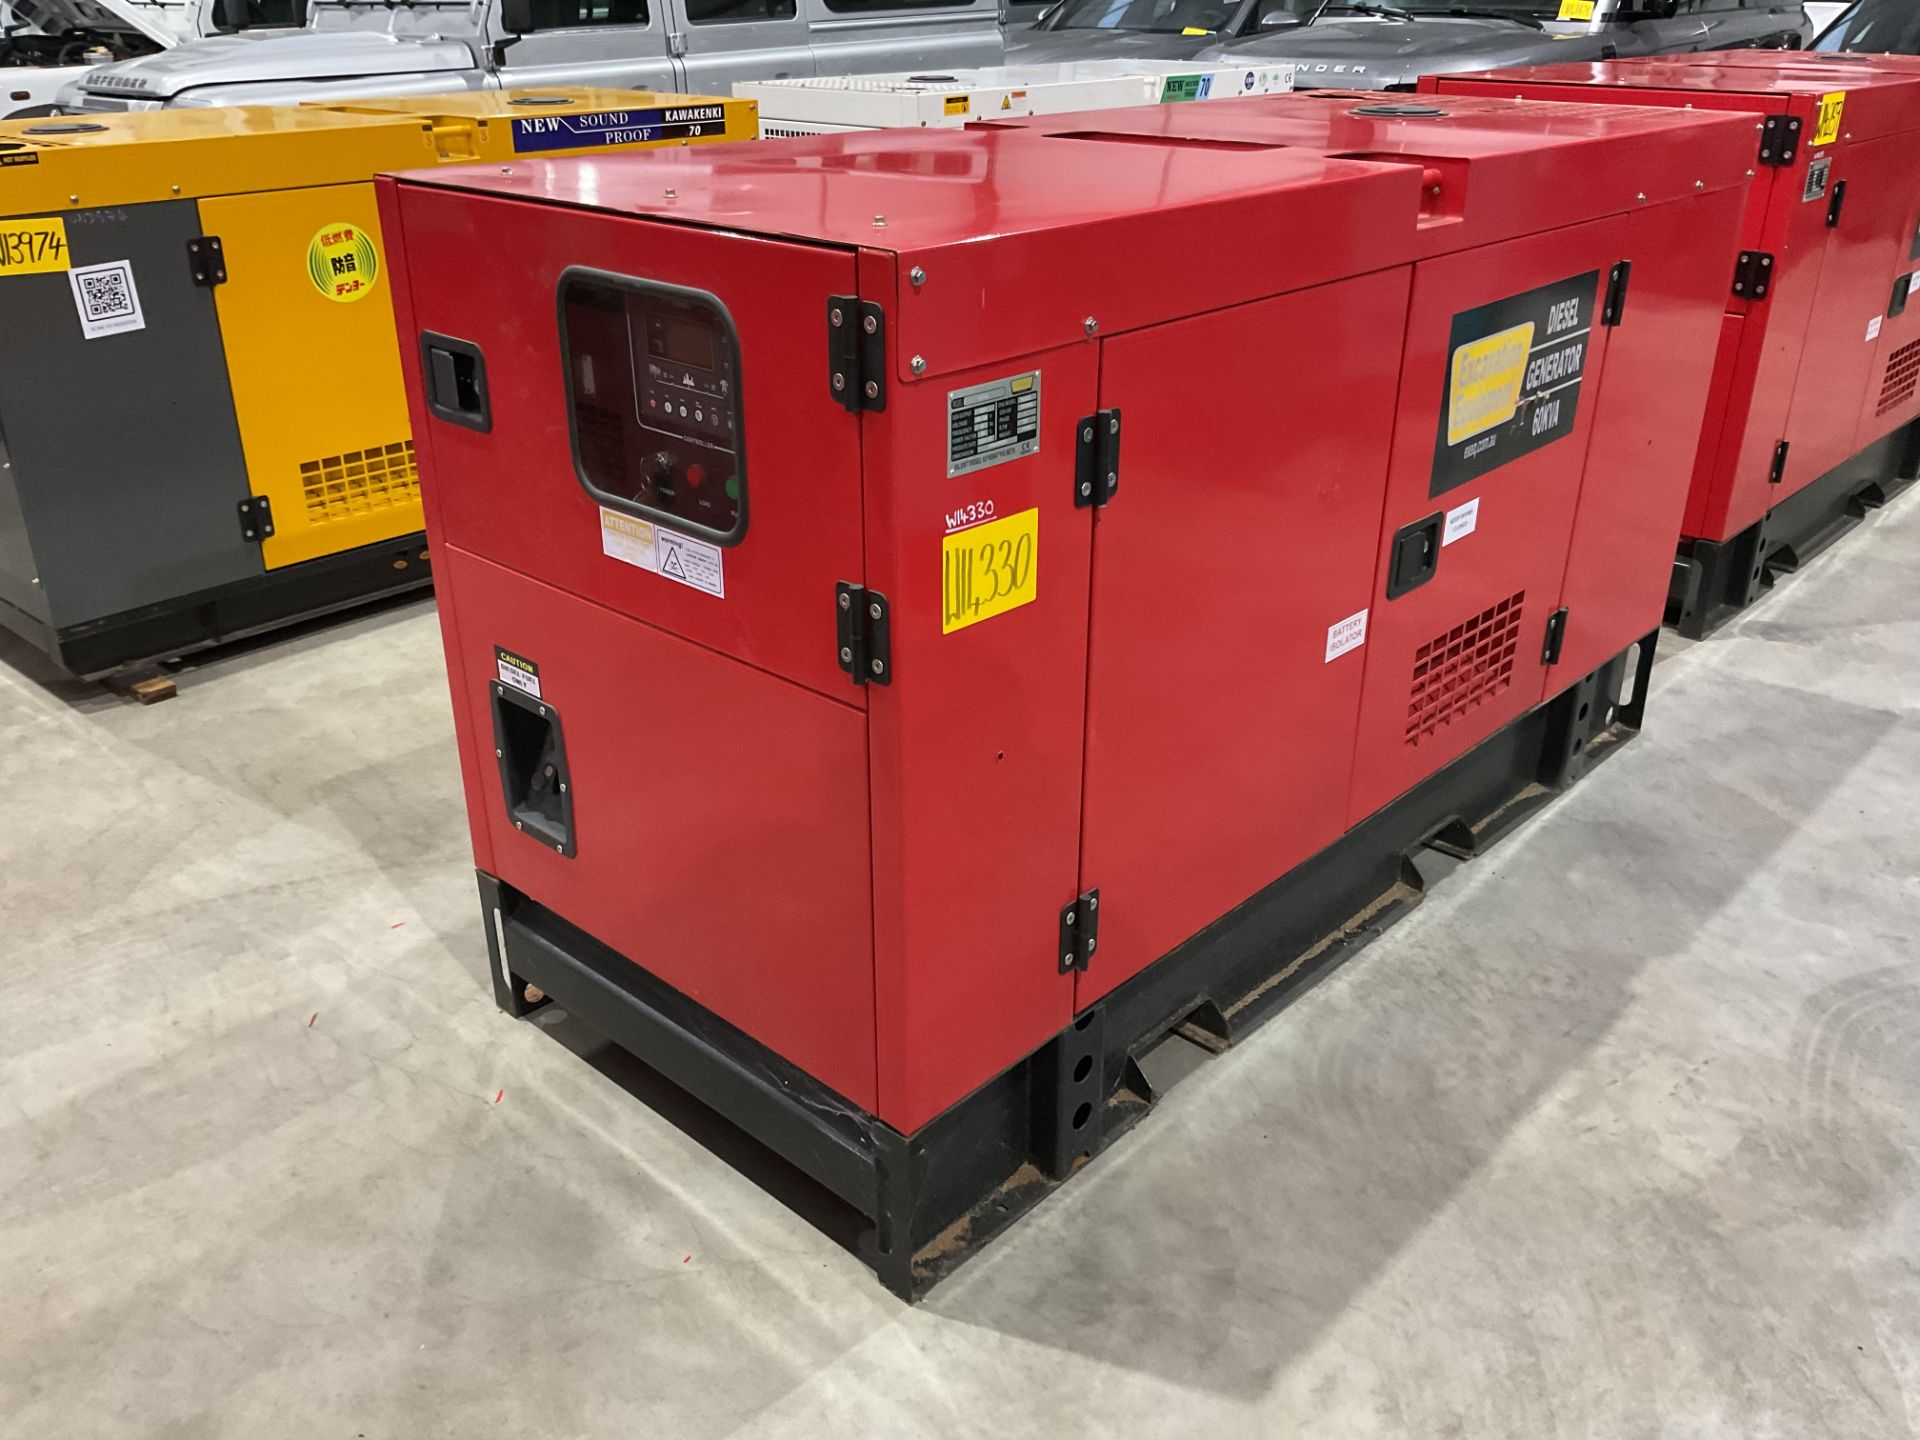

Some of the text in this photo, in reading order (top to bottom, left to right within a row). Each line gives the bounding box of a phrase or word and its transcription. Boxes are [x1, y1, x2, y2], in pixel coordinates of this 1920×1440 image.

[1166, 80, 1185, 92] NEW
[1200, 78, 1211, 96] 70
[521, 112, 629, 134] NEW SOUND
[665, 107, 722, 122] KAWAKENKI
[605, 129, 651, 144] PROOF
[689, 125, 701, 137] 70
[331, 253, 356, 276] 防音
[1547, 297, 1579, 335] DIESEL
[1459, 339, 1523, 388] Excavation
[1526, 344, 1582, 391] GENERATOR
[945, 500, 995, 529] W14330
[604, 513, 653, 543] ATTENTION
[945, 533, 1032, 626] W14330
[1332, 617, 1362, 639] BATTERY
[1330, 629, 1363, 651] ISOLATOR
[501, 652, 534, 673] CAUTION
[511, 677, 527, 688] ONLY
